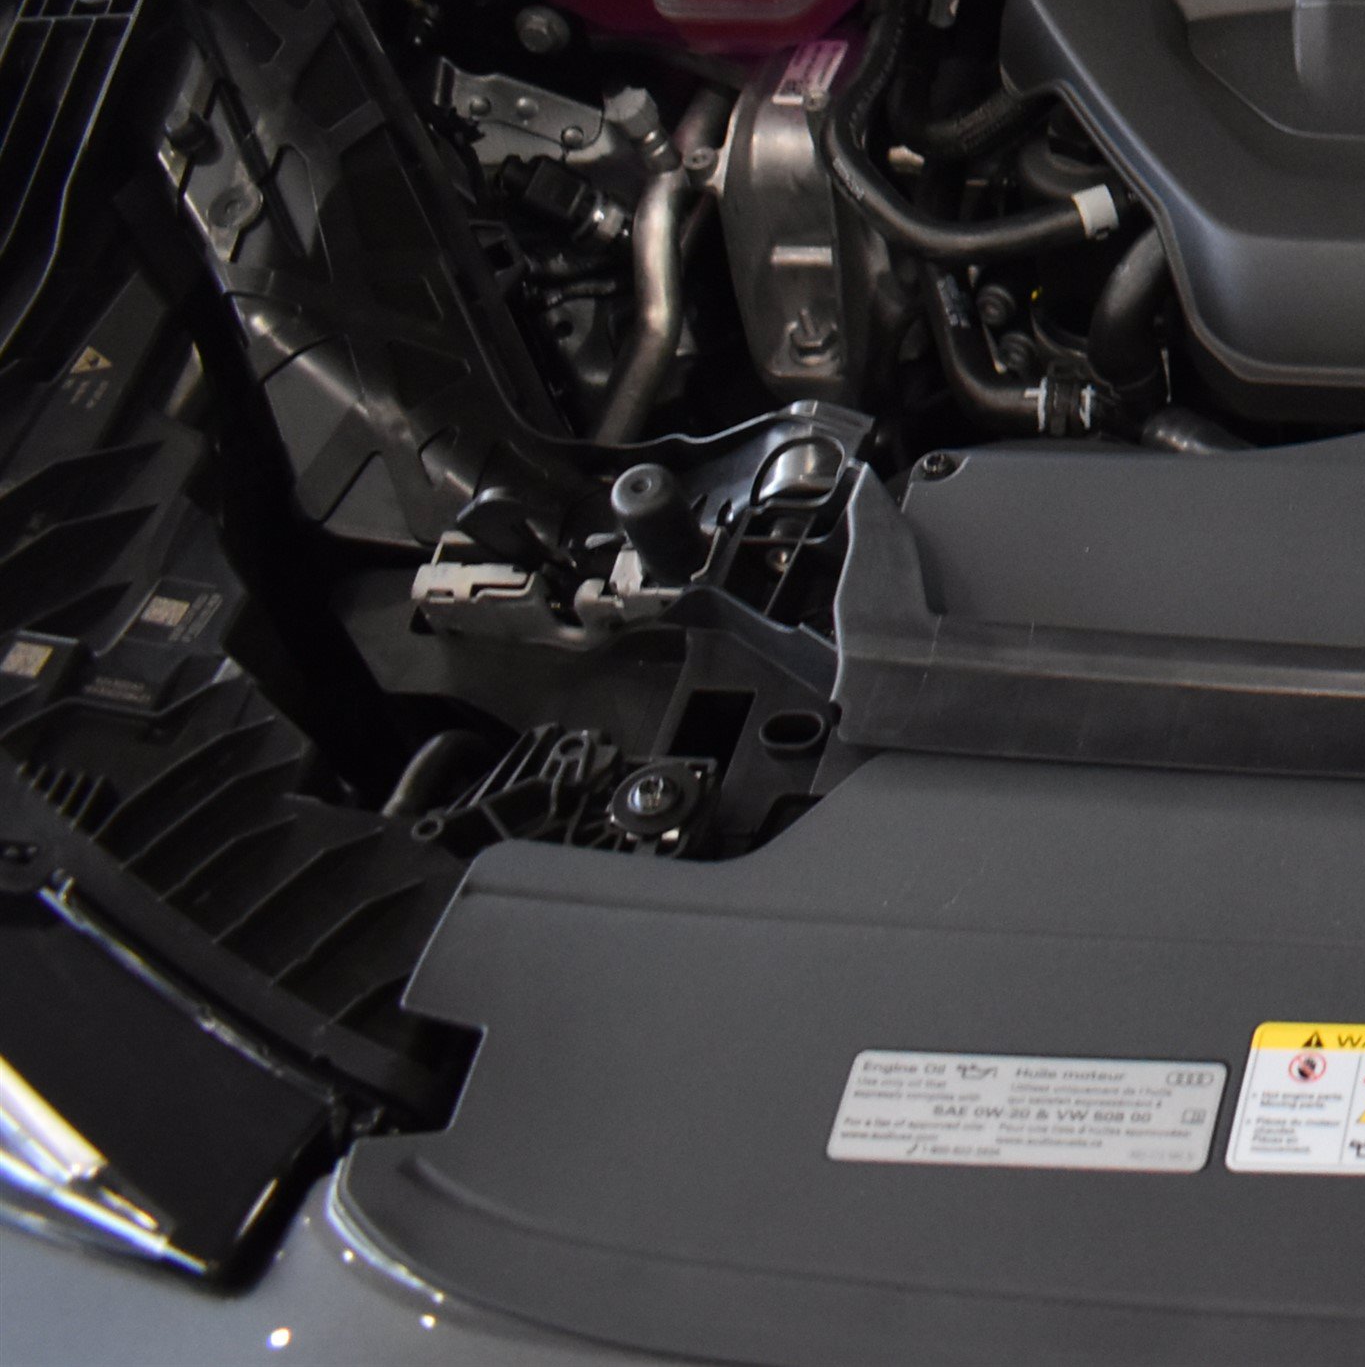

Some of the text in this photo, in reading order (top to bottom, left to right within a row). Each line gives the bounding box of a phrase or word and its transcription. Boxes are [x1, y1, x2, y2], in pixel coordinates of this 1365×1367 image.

[862, 1060, 946, 1076] Engine Oil
[933, 1104, 969, 1117] SAE
[1055, 1108, 1090, 1122] VW
